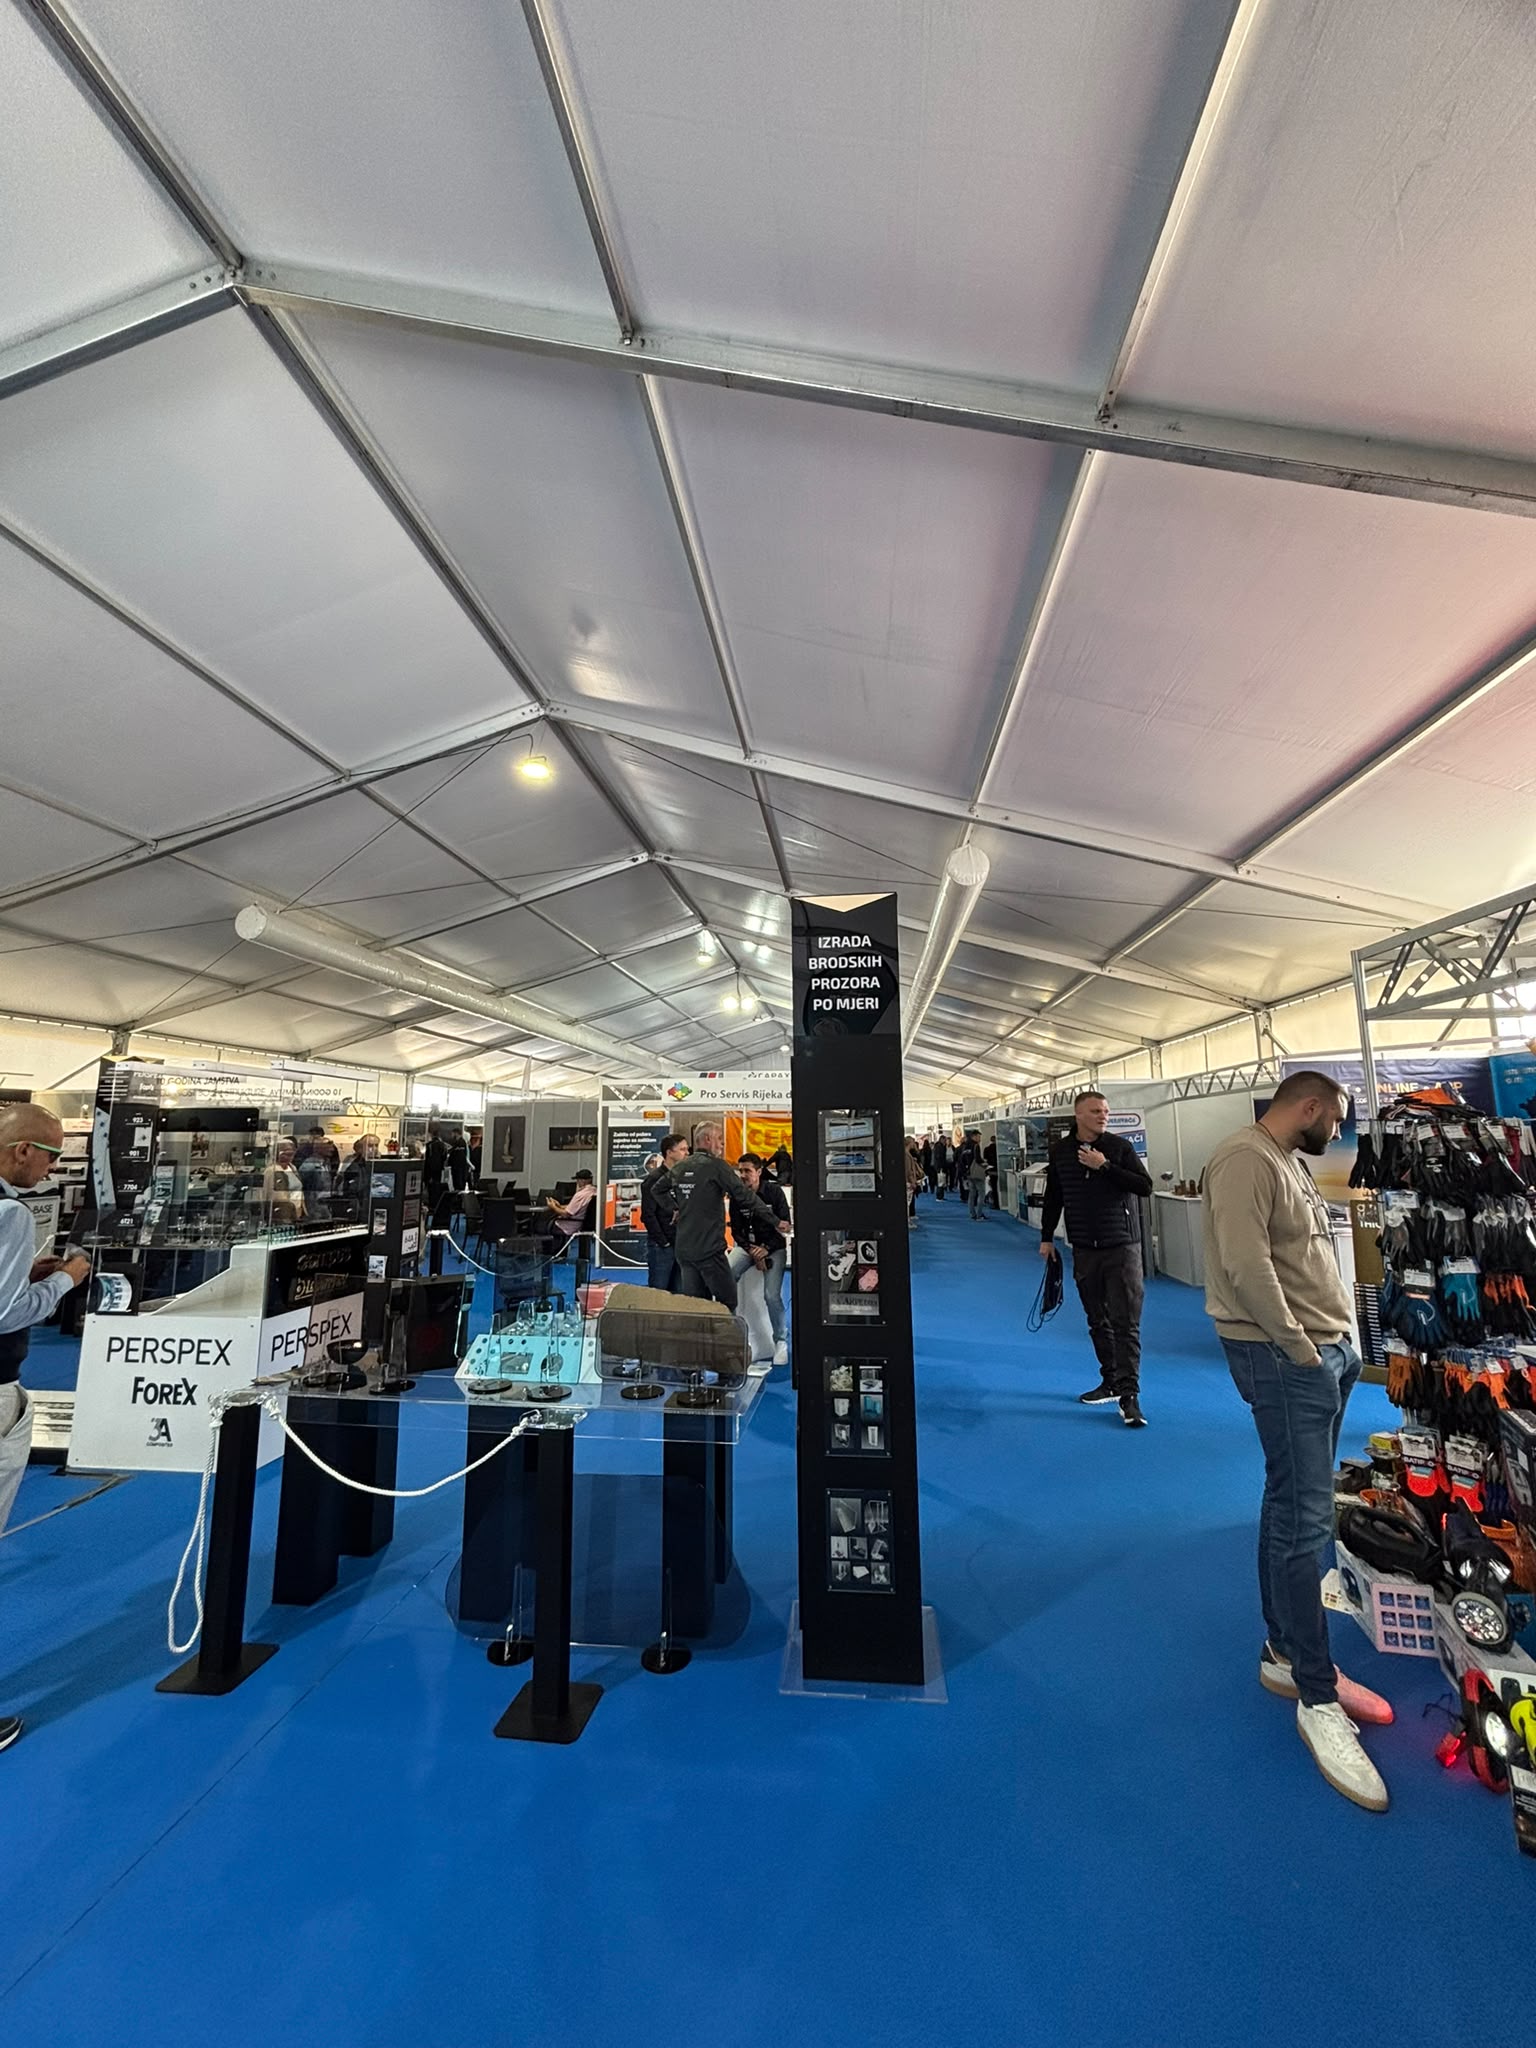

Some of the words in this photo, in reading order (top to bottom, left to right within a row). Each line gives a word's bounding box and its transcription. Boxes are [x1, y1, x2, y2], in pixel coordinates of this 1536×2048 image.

[818, 935, 872, 949] IZRADA
[808, 955, 882, 970] BRODSKIH
[811, 976, 880, 990] PROZORA
[813, 999, 833, 1011] PO
[836, 997, 879, 1010] MJERI
[1376, 1082, 1419, 1093] NLINE
[700, 1089, 718, 1099] Pro
[719, 1089, 750, 1099] Servis
[752, 1089, 783, 1101] Rijeka
[271, 1312, 352, 1362] PERSPEX
[106, 1336, 233, 1366] PERSPEX
